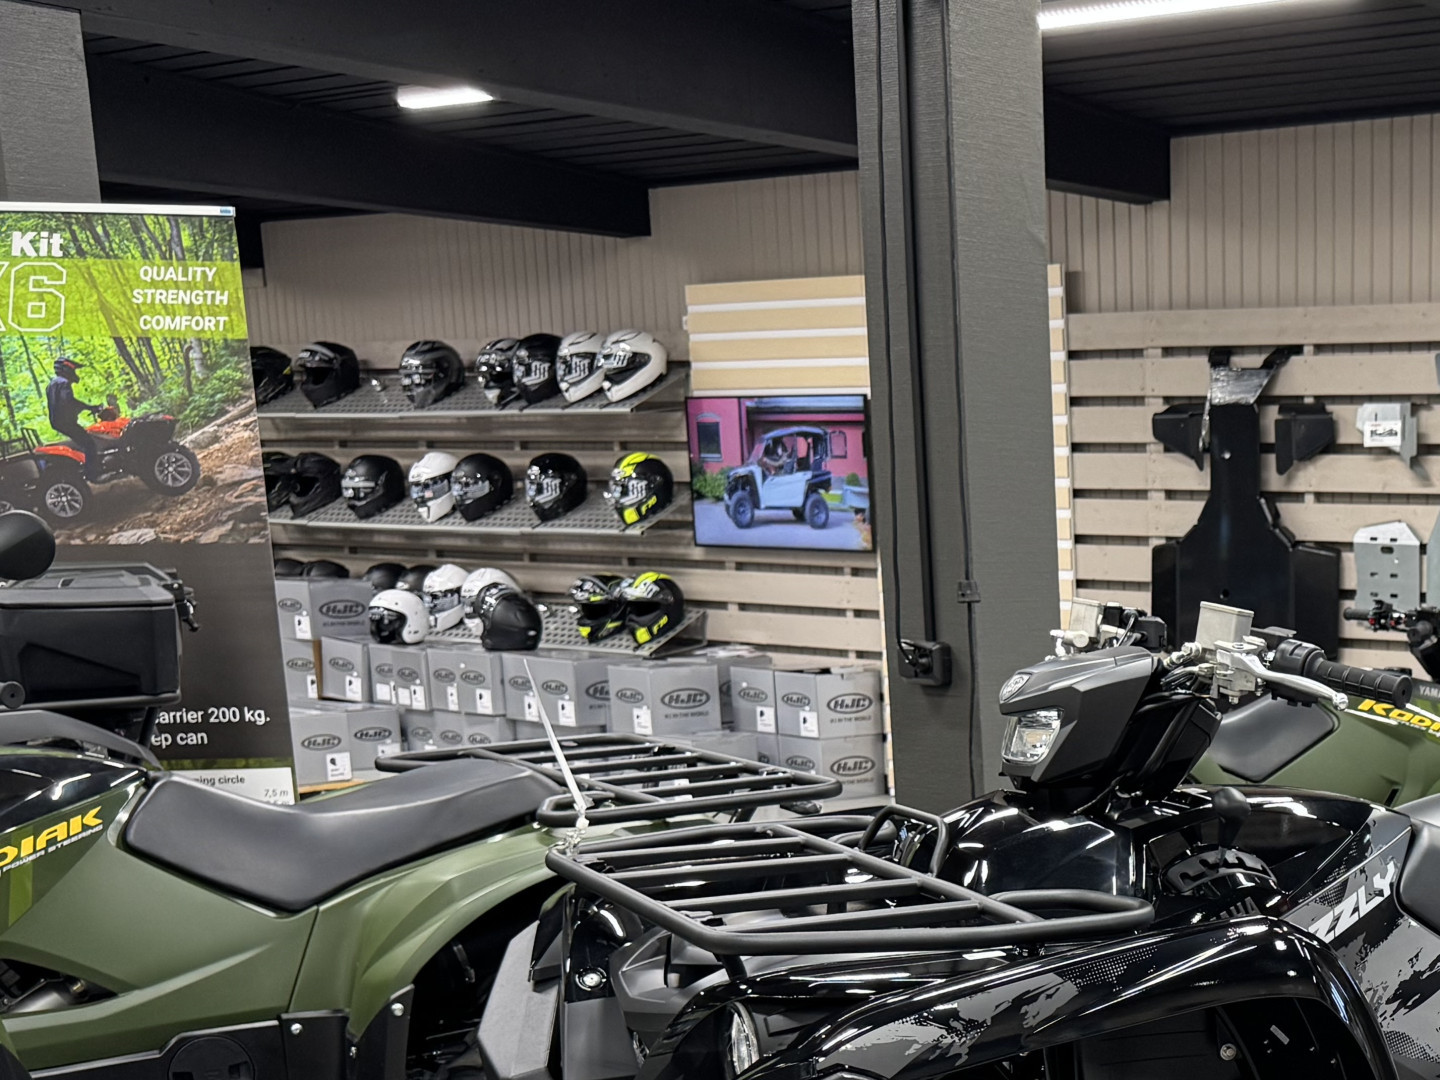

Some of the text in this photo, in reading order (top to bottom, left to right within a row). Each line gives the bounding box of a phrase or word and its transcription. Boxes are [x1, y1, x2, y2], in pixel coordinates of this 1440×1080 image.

[11, 231, 64, 257] Kit
[139, 266, 217, 283] QUALITY
[132, 289, 229, 306] STRENGTH
[139, 315, 228, 331] COMFORT
[155, 706, 271, 726] arrier 200 kg.
[176, 732, 208, 745] can
[218, 774, 246, 785] circle
[263, 788, 279, 799] 7,5
[48, 823, 104, 853] STEERING
